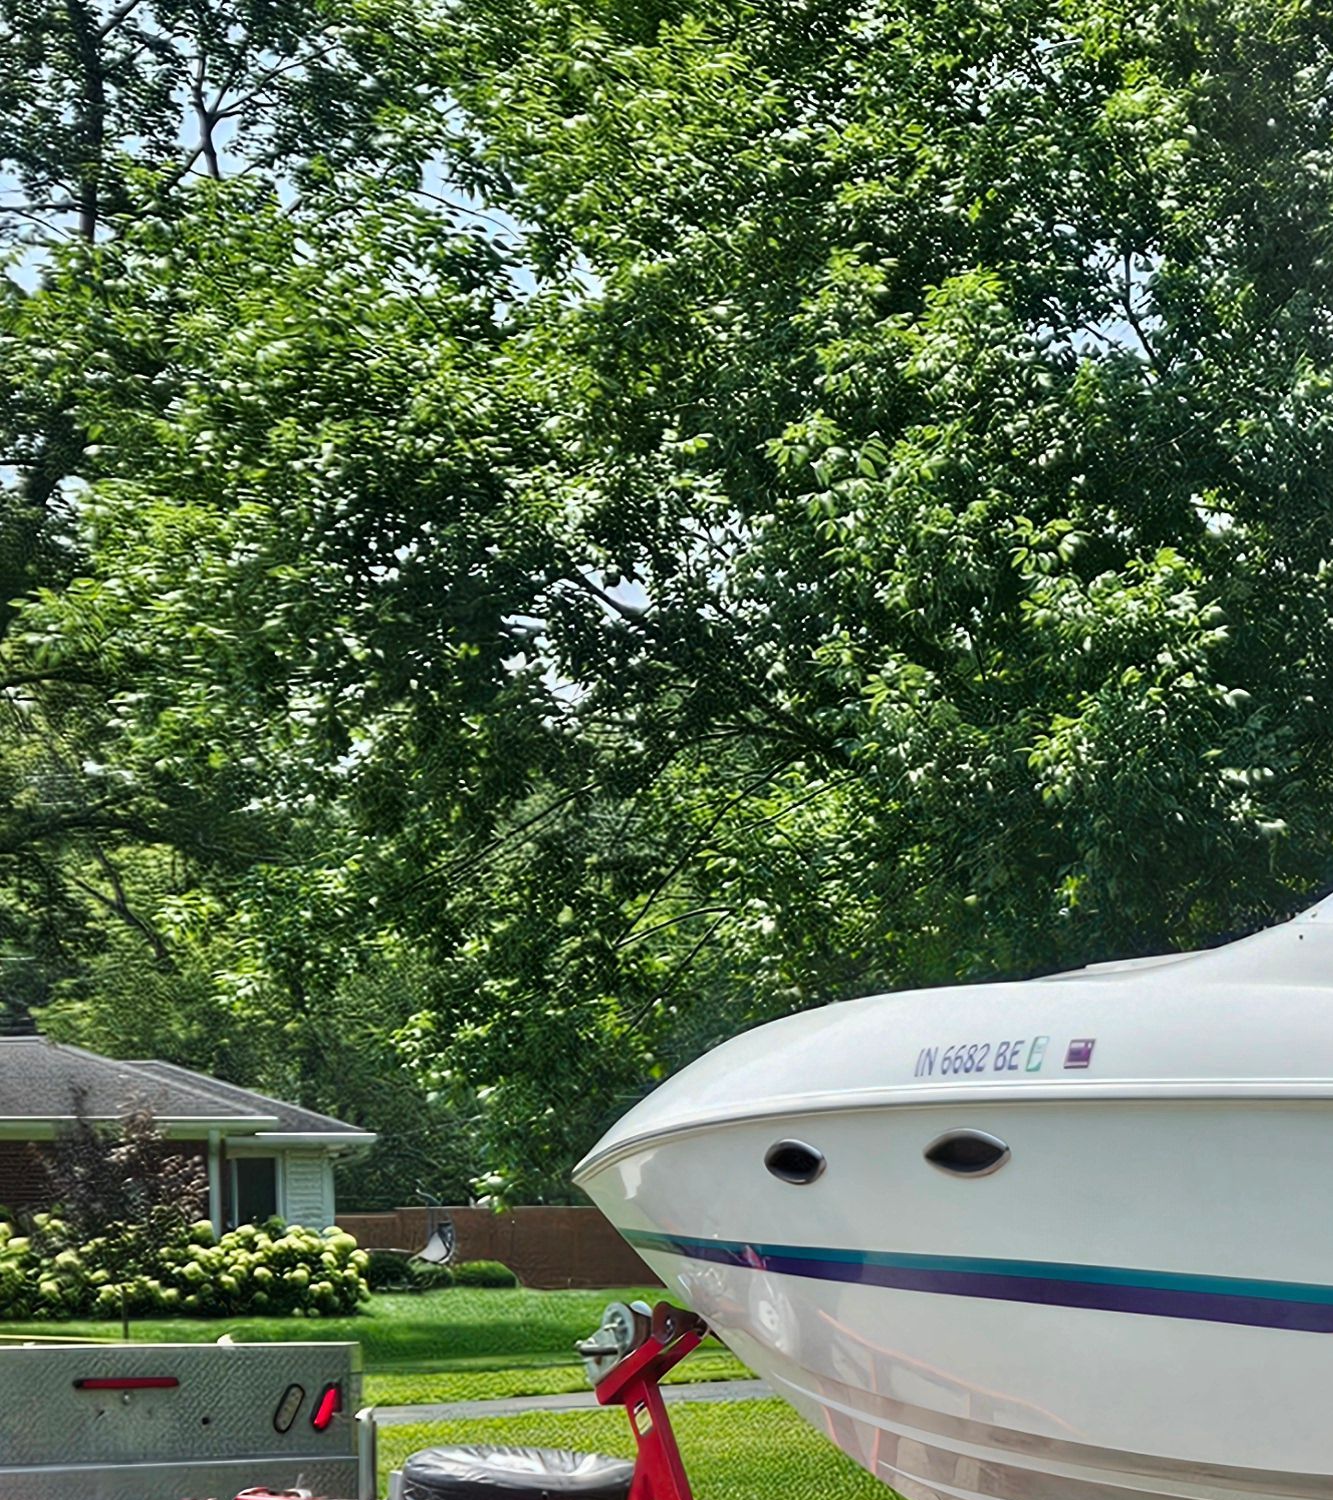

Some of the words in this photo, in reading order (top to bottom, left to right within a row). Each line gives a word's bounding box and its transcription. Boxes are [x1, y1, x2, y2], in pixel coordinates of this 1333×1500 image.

[913, 1047, 939, 1077] IN
[940, 1042, 991, 1075] 6682
[992, 1039, 1026, 1072] BE
